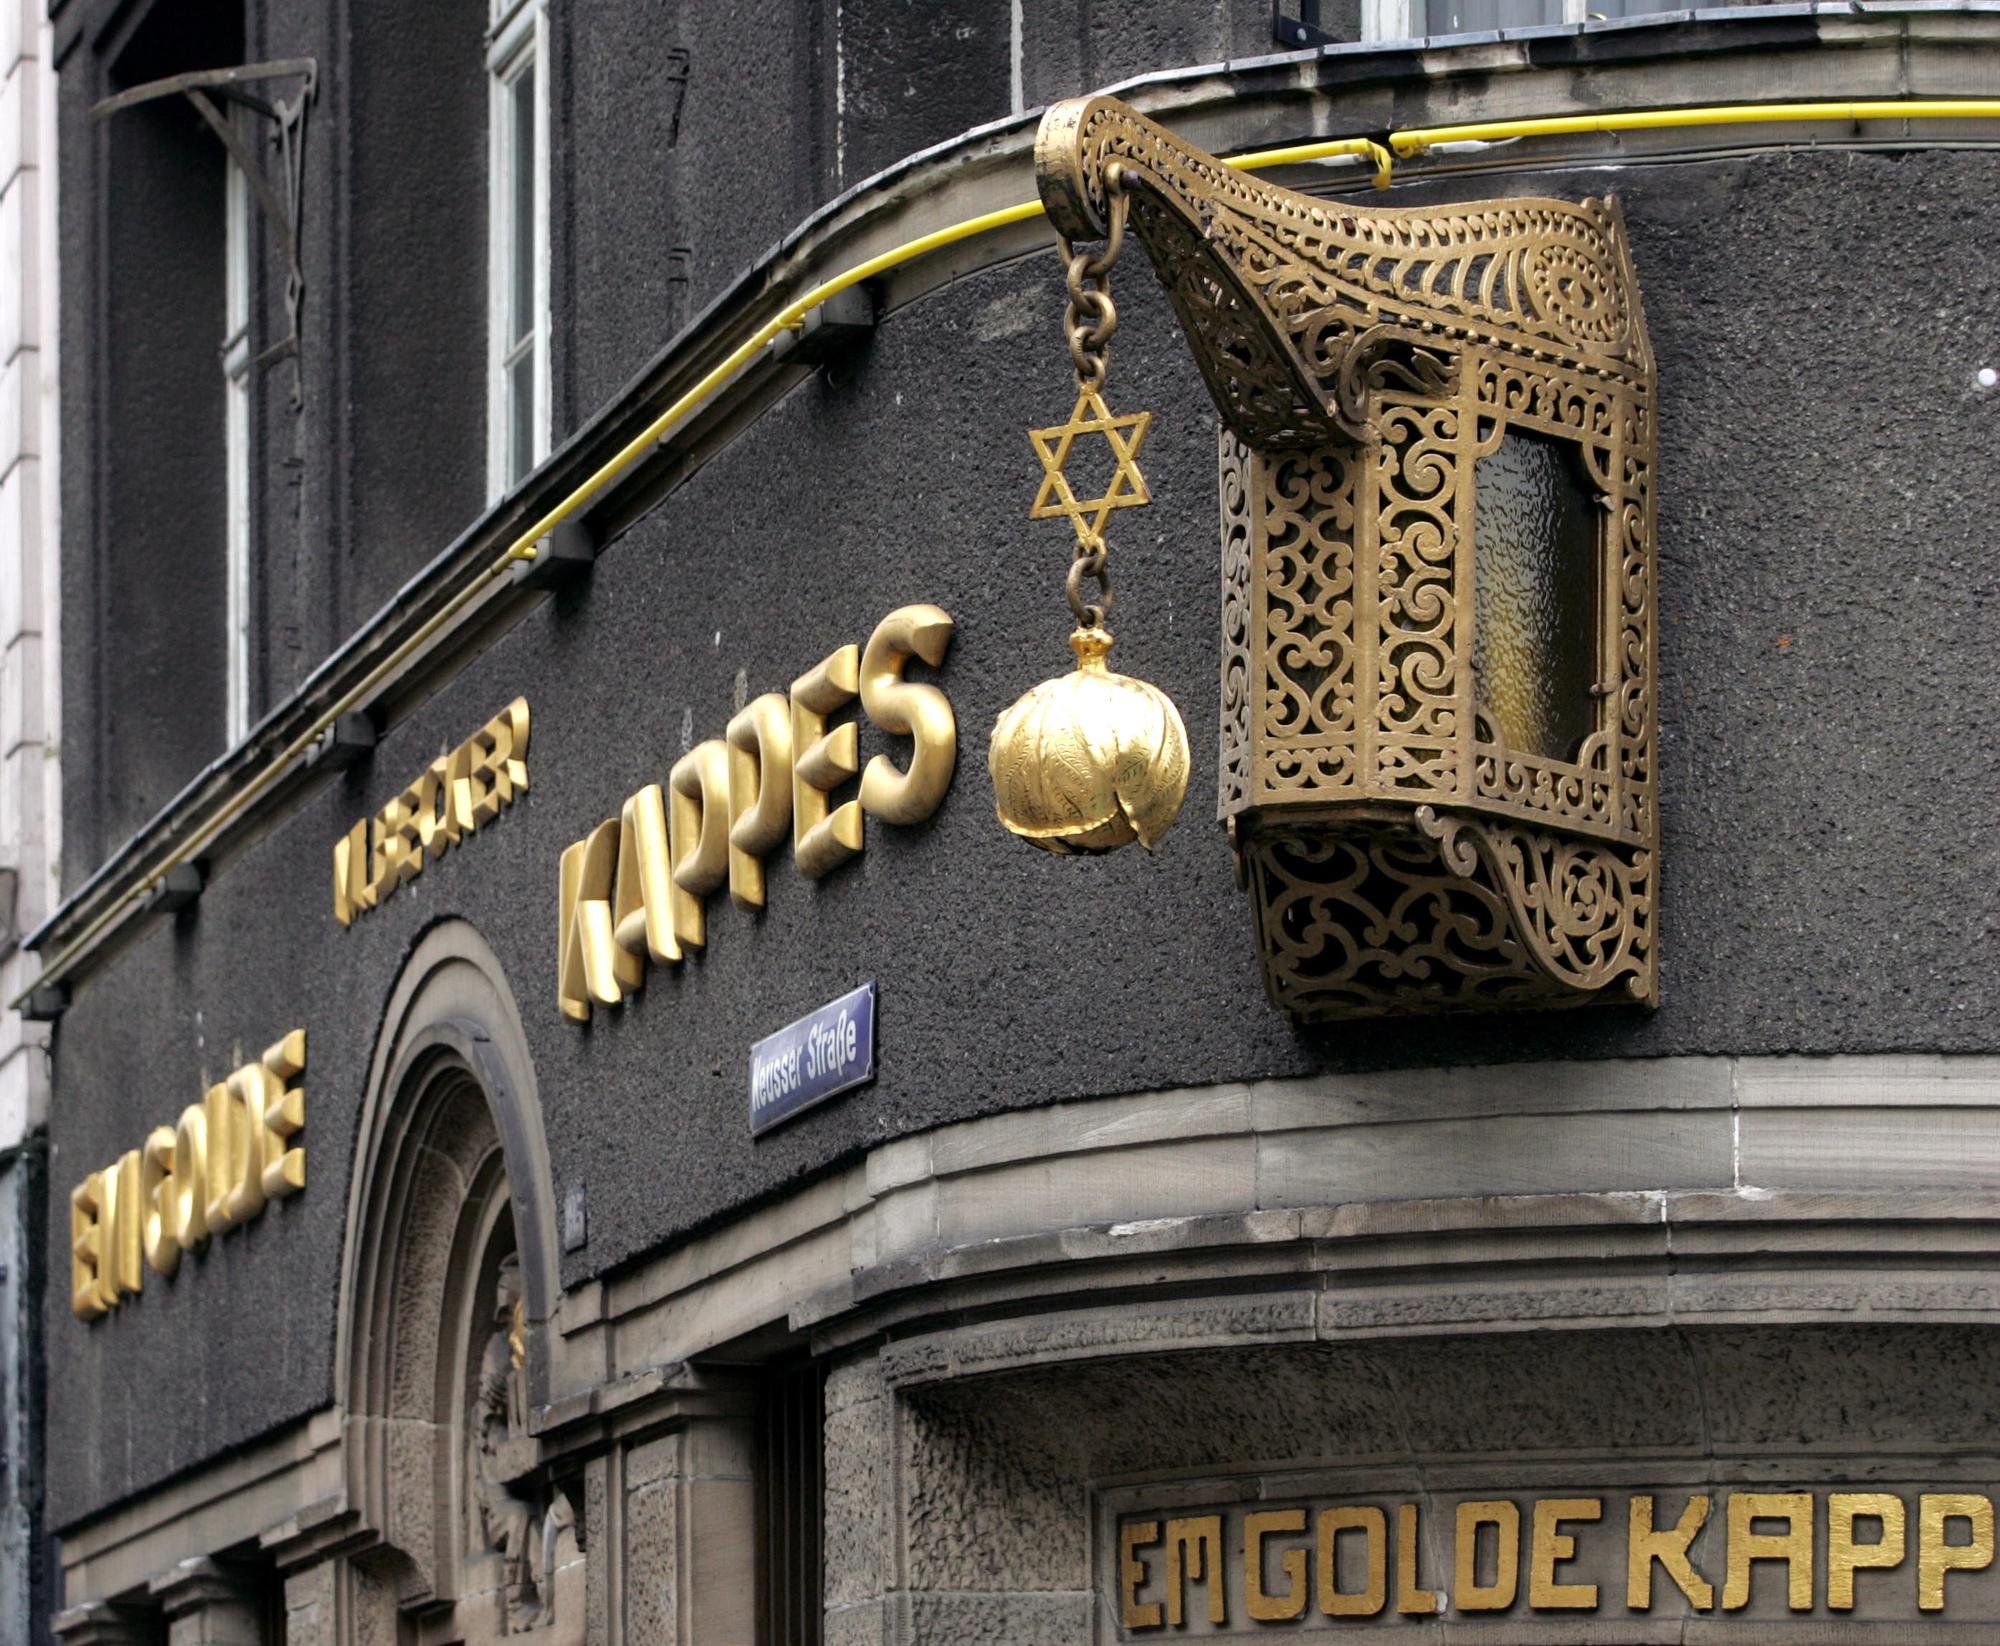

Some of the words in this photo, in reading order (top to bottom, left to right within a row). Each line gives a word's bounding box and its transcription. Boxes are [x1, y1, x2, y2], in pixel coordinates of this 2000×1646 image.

[143, 1028, 306, 1275] GOLDE
[559, 604, 956, 1021] KAPPES
[752, 1045, 803, 1112] Neusser
[806, 1008, 857, 1080] Straße
[1121, 1515, 1225, 1629] EM
[1244, 1499, 1601, 1621] GOLDE
[1627, 1492, 1994, 1612] KAPP
